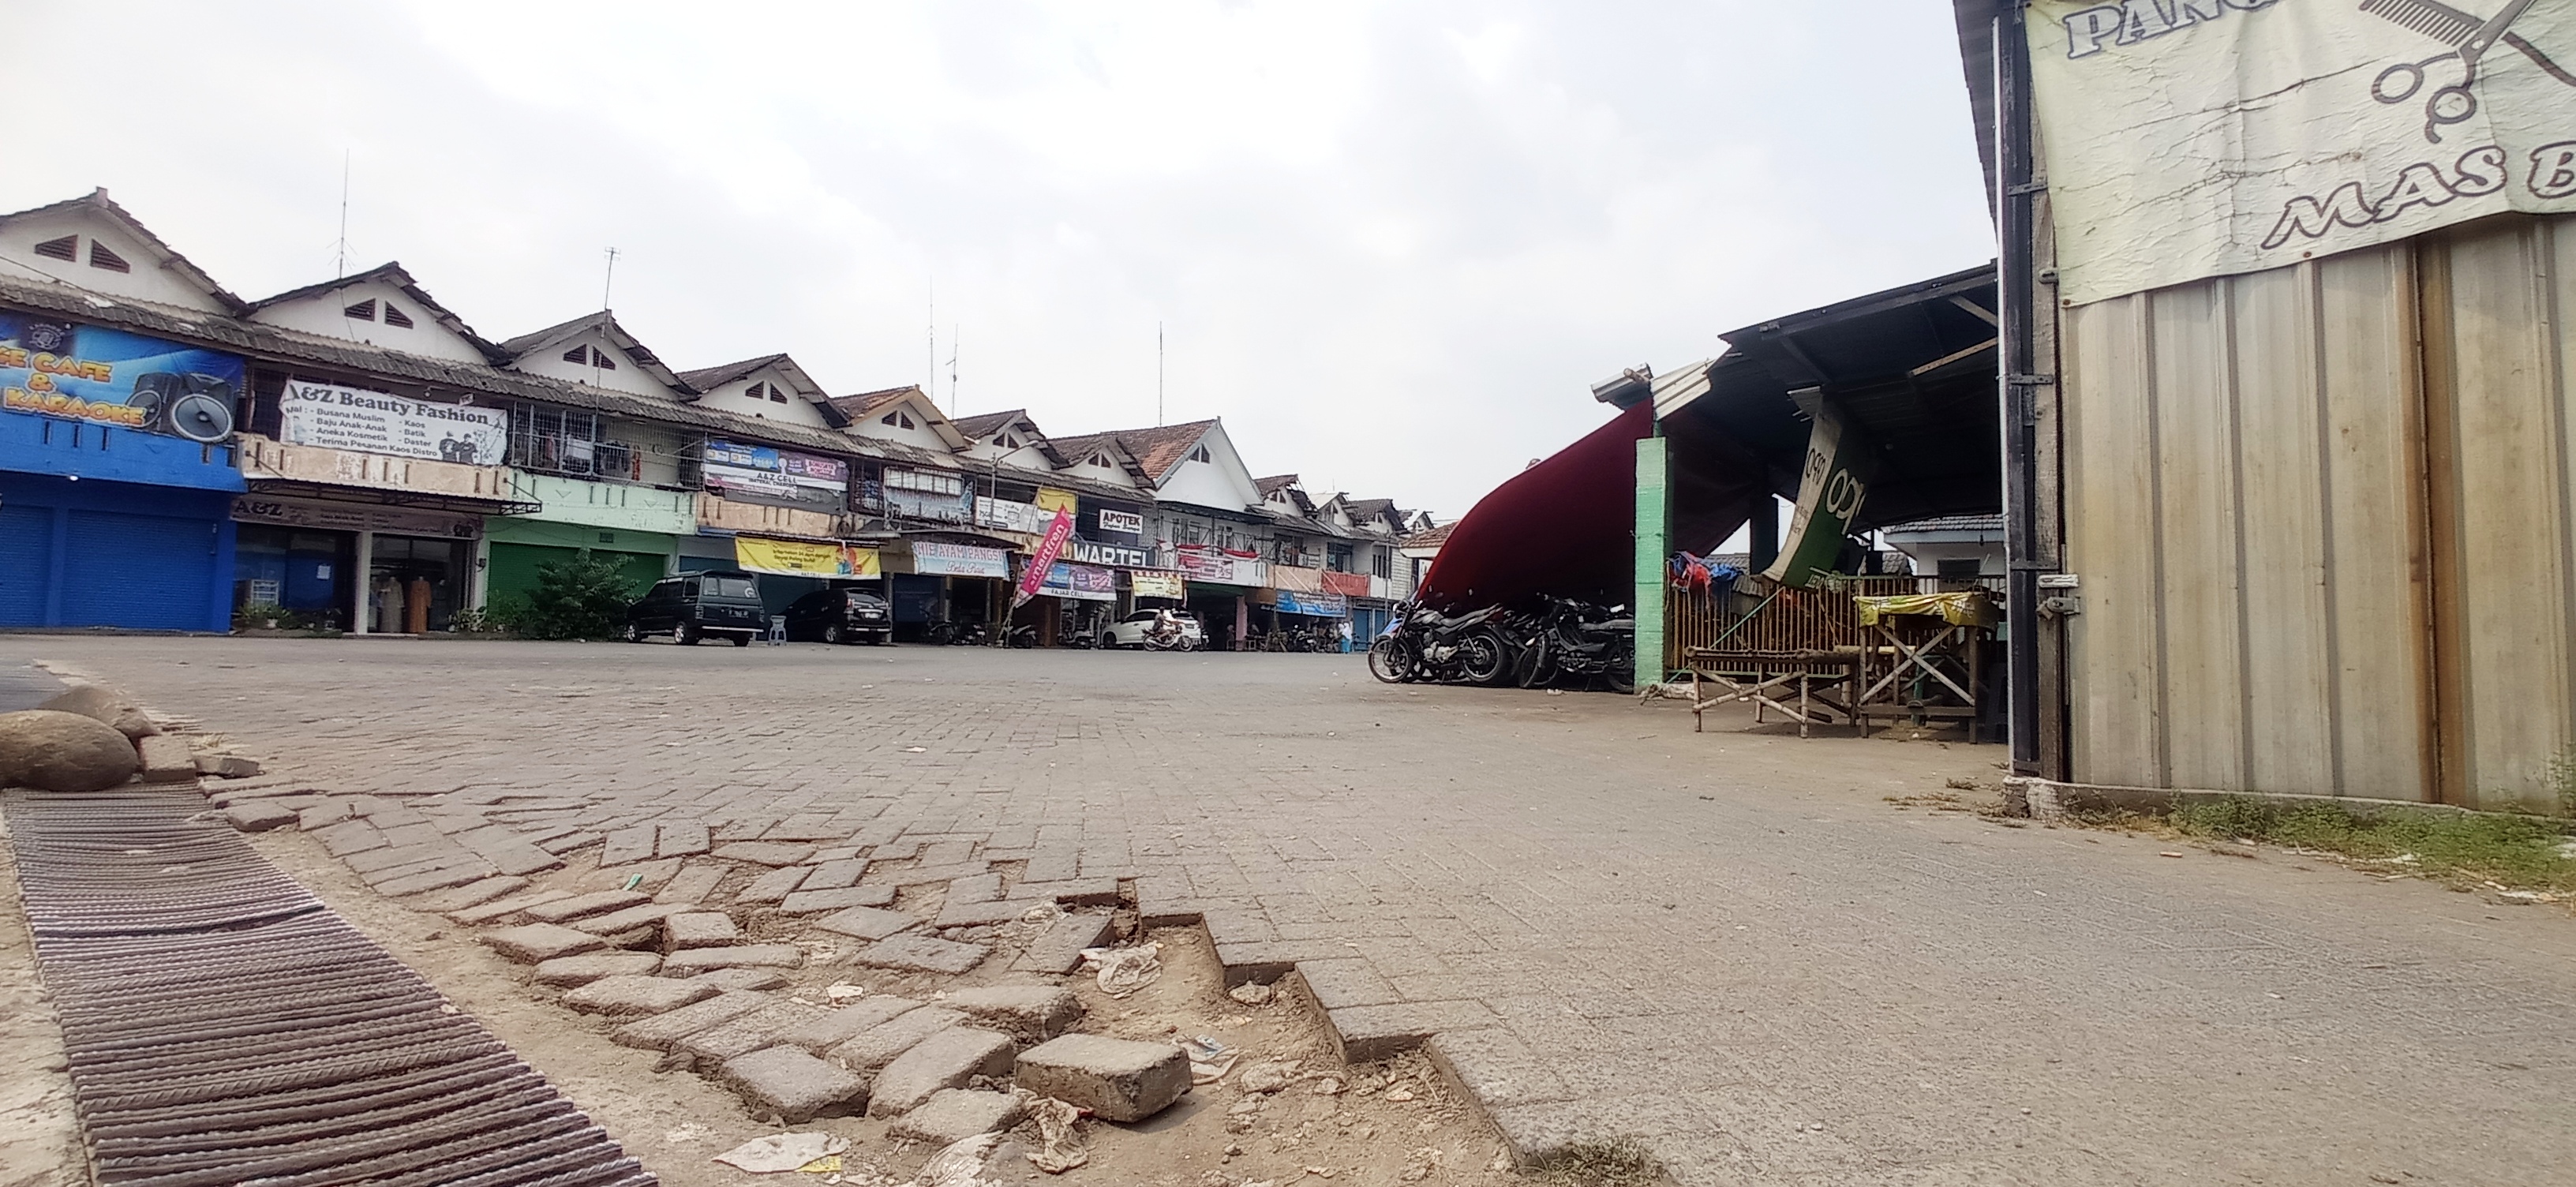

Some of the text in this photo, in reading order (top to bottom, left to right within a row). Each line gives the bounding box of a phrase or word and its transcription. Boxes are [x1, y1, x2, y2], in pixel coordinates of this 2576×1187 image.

[2260, 145, 2508, 249] MAS
[32, 353, 112, 383] CAFE
[28, 373, 54, 392] &
[5, 389, 147, 426] KARAOKE
[339, 391, 411, 416] Beauty
[415, 403, 489, 425] Fashion
[316, 408, 350, 419] Busana
[353, 413, 386, 423] Muslim
[316, 418, 388, 432] Baju Anak-Anak
[404, 420, 425, 429] Kaos
[316, 427, 388, 442] Aneka Kosmetik
[404, 429, 426, 437] Batik
[316, 436, 438, 457] Terima Pesanan Kaos Distro
[404, 437, 432, 447] Daster
[1103, 512, 1140, 526] APOTEK
[939, 545, 964, 558] AYAM
